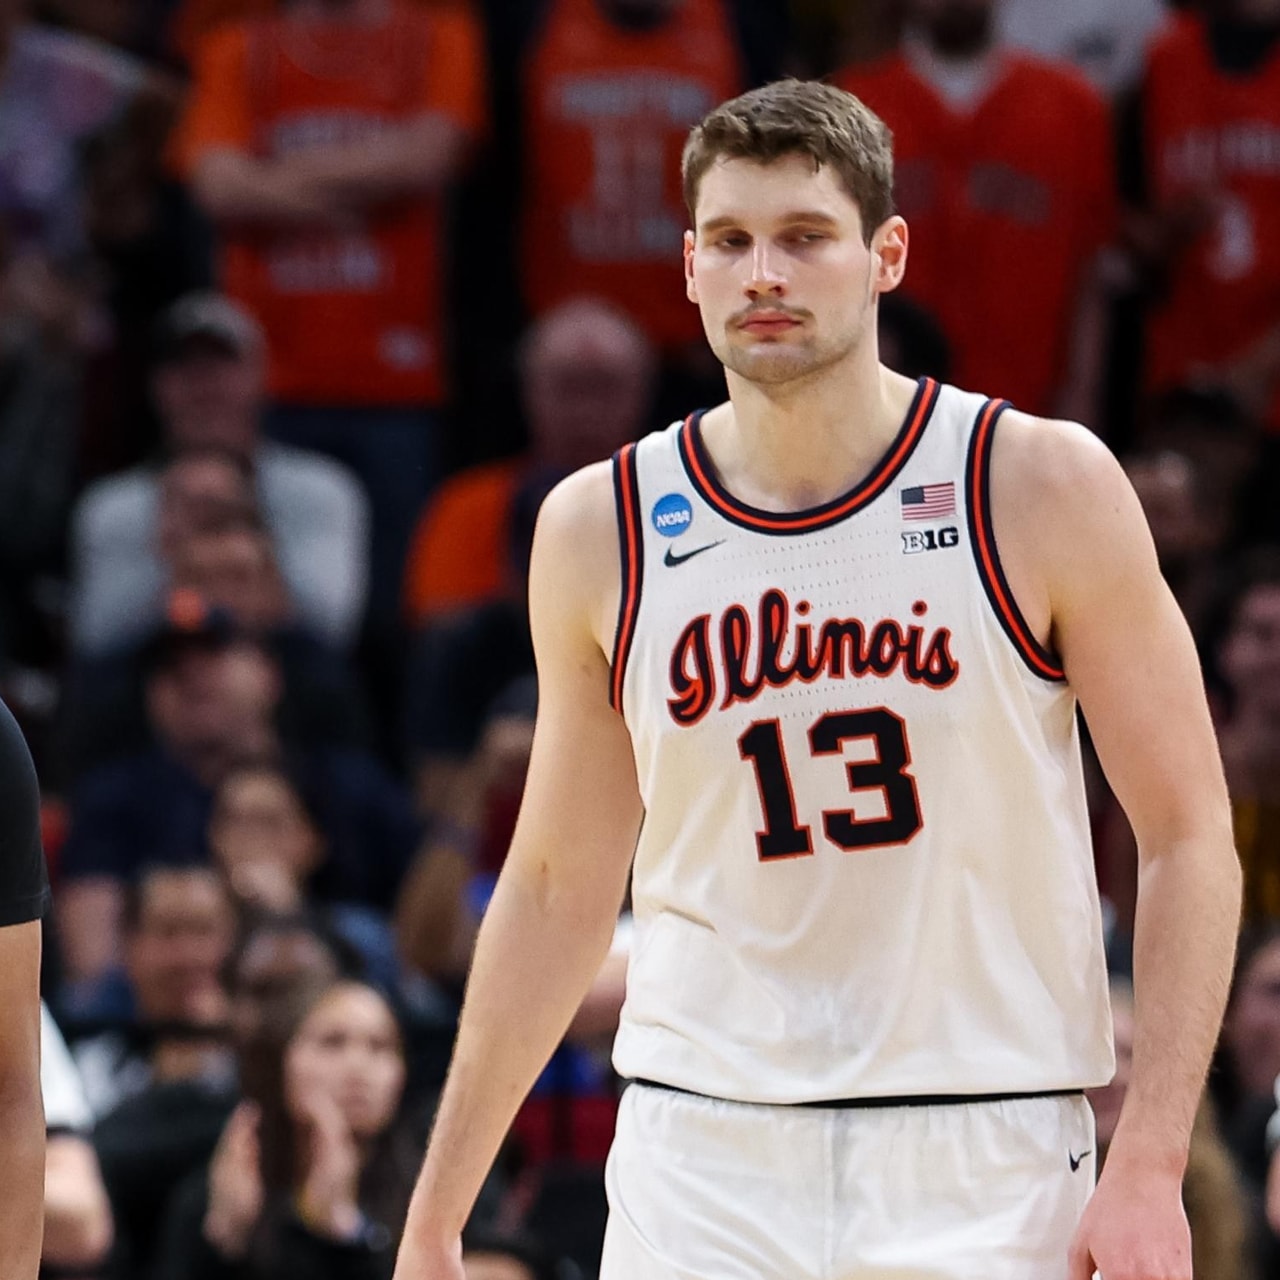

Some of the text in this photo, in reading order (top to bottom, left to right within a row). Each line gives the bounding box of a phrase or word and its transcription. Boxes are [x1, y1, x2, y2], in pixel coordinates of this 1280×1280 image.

[656, 510, 690, 528] NCAA
[666, 587, 960, 728] Illinois
[737, 706, 924, 863] 13
